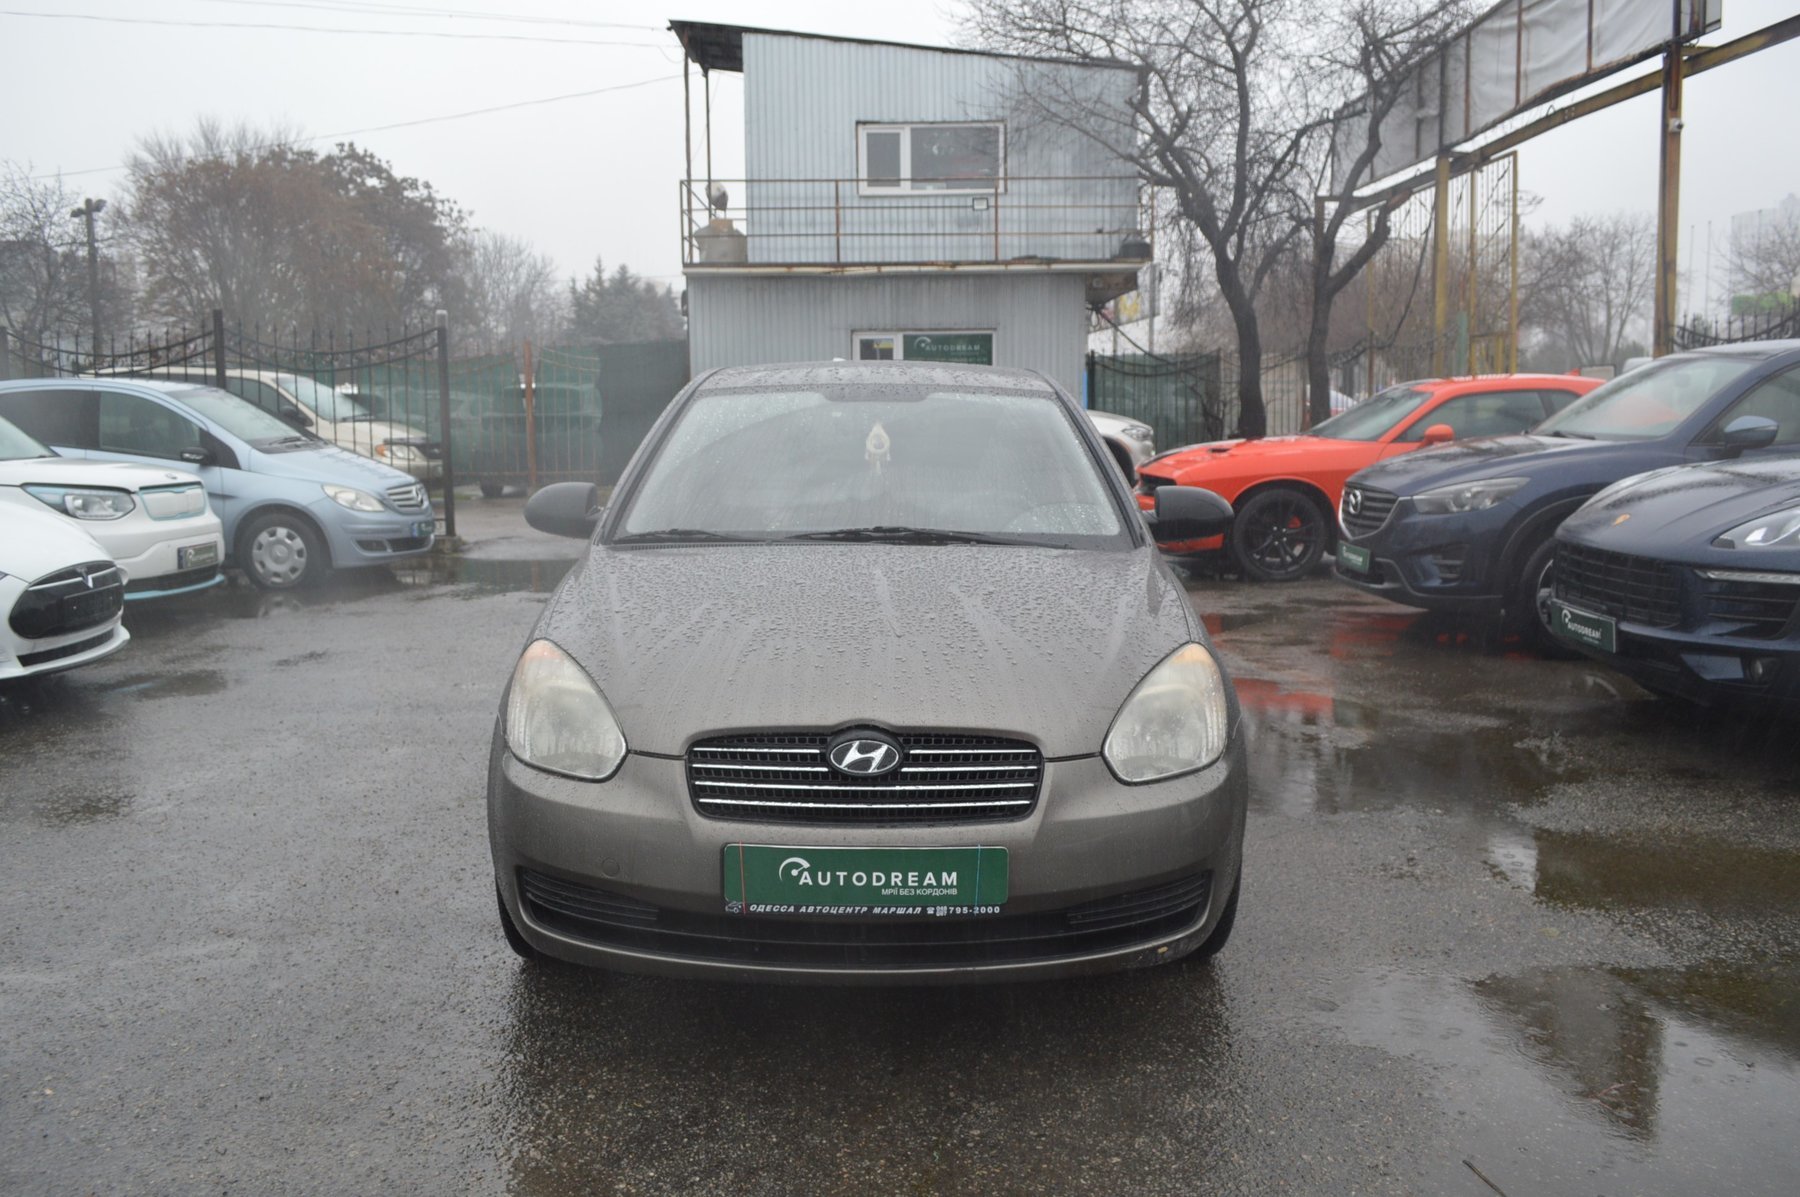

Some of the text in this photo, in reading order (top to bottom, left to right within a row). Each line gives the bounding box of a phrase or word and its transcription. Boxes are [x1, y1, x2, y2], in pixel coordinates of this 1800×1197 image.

[925, 344, 980, 352] AUTODREAM
[799, 871, 957, 886] AUTODREAM
[916, 888, 958, 896] КОРДОНІВ
[749, 904, 794, 912] ОДЕССА
[799, 905, 868, 914] АВТОЦЕНТР
